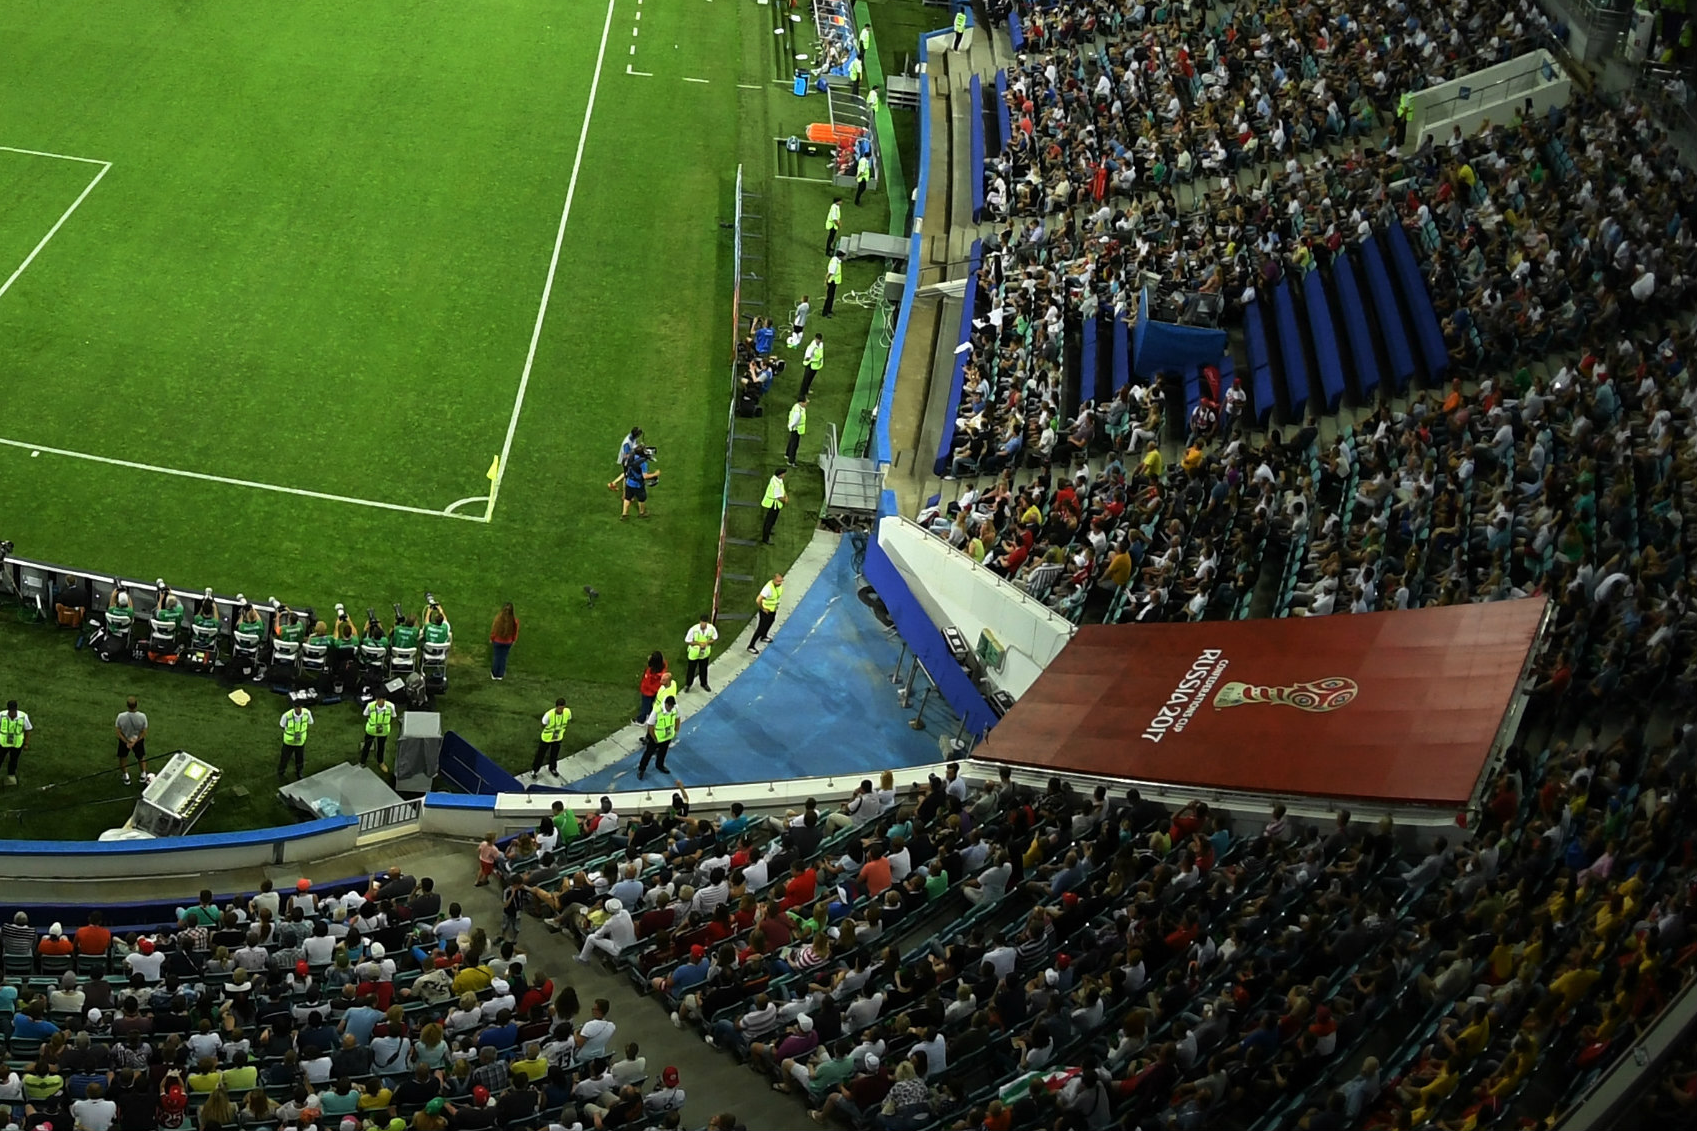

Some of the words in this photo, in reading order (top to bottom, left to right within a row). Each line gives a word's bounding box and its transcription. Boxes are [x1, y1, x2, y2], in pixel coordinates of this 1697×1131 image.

[1166, 648, 1222, 706] RUSSIA
[1188, 660, 1229, 718] CONFEDERATIONS
[1142, 704, 1182, 743] 2017
[1172, 718, 1189, 732] CUP
